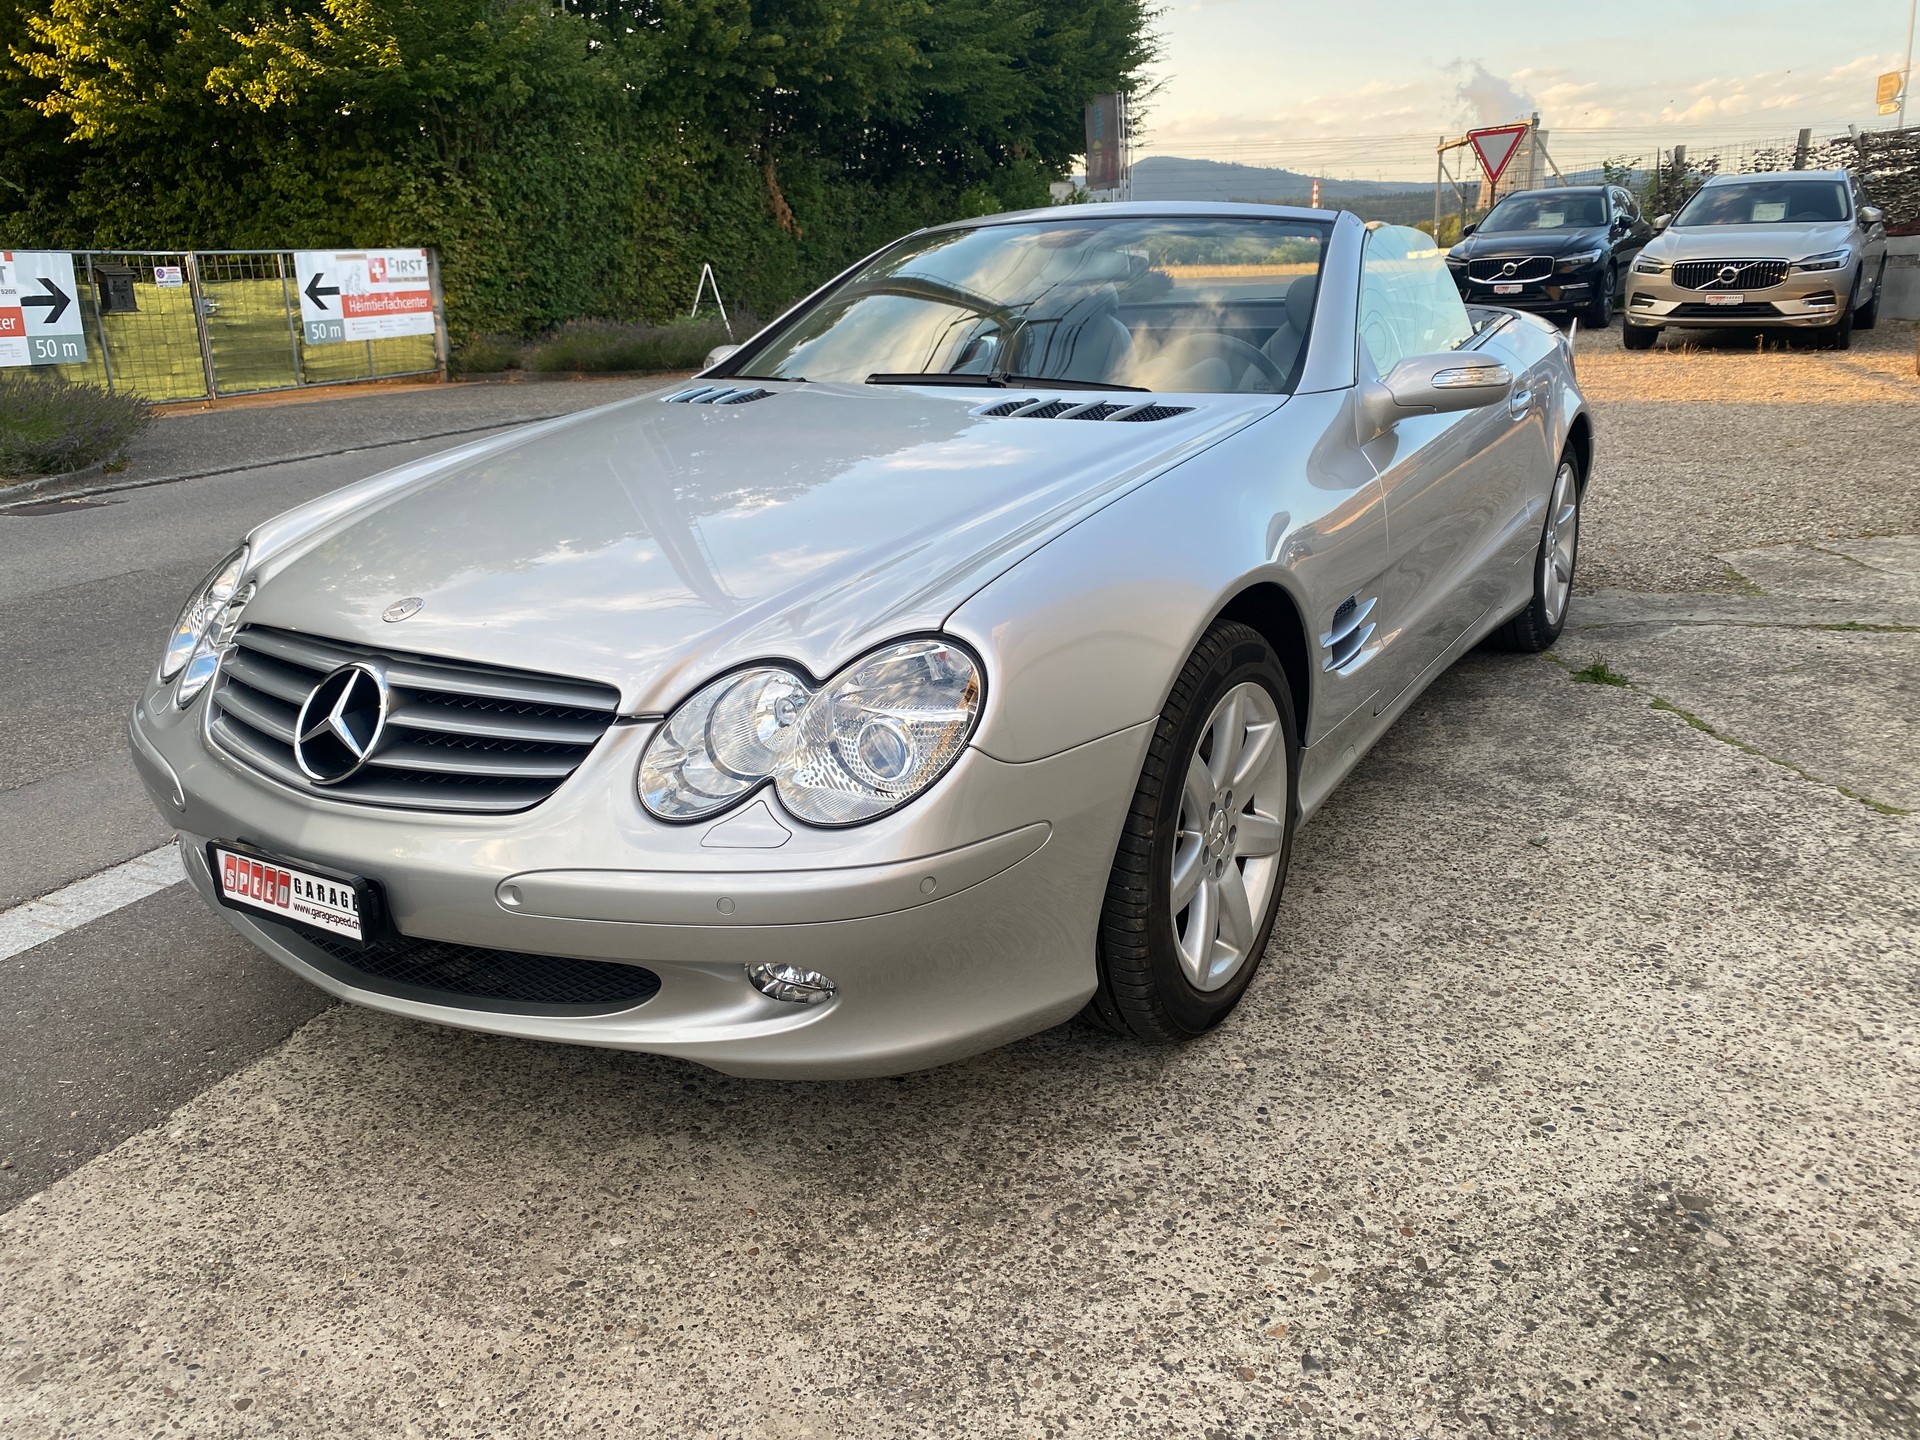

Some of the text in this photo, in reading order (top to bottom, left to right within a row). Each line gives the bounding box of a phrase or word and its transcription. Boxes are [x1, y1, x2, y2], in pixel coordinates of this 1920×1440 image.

[349, 298, 428, 312] Heimtierfachcenter
[311, 323, 327, 339] 50
[330, 325, 342, 338] m
[35, 339, 57, 358] 50
[62, 342, 78, 357] m
[225, 867, 290, 905] SPEED
[293, 901, 361, 930] www.garagespeed.ch
